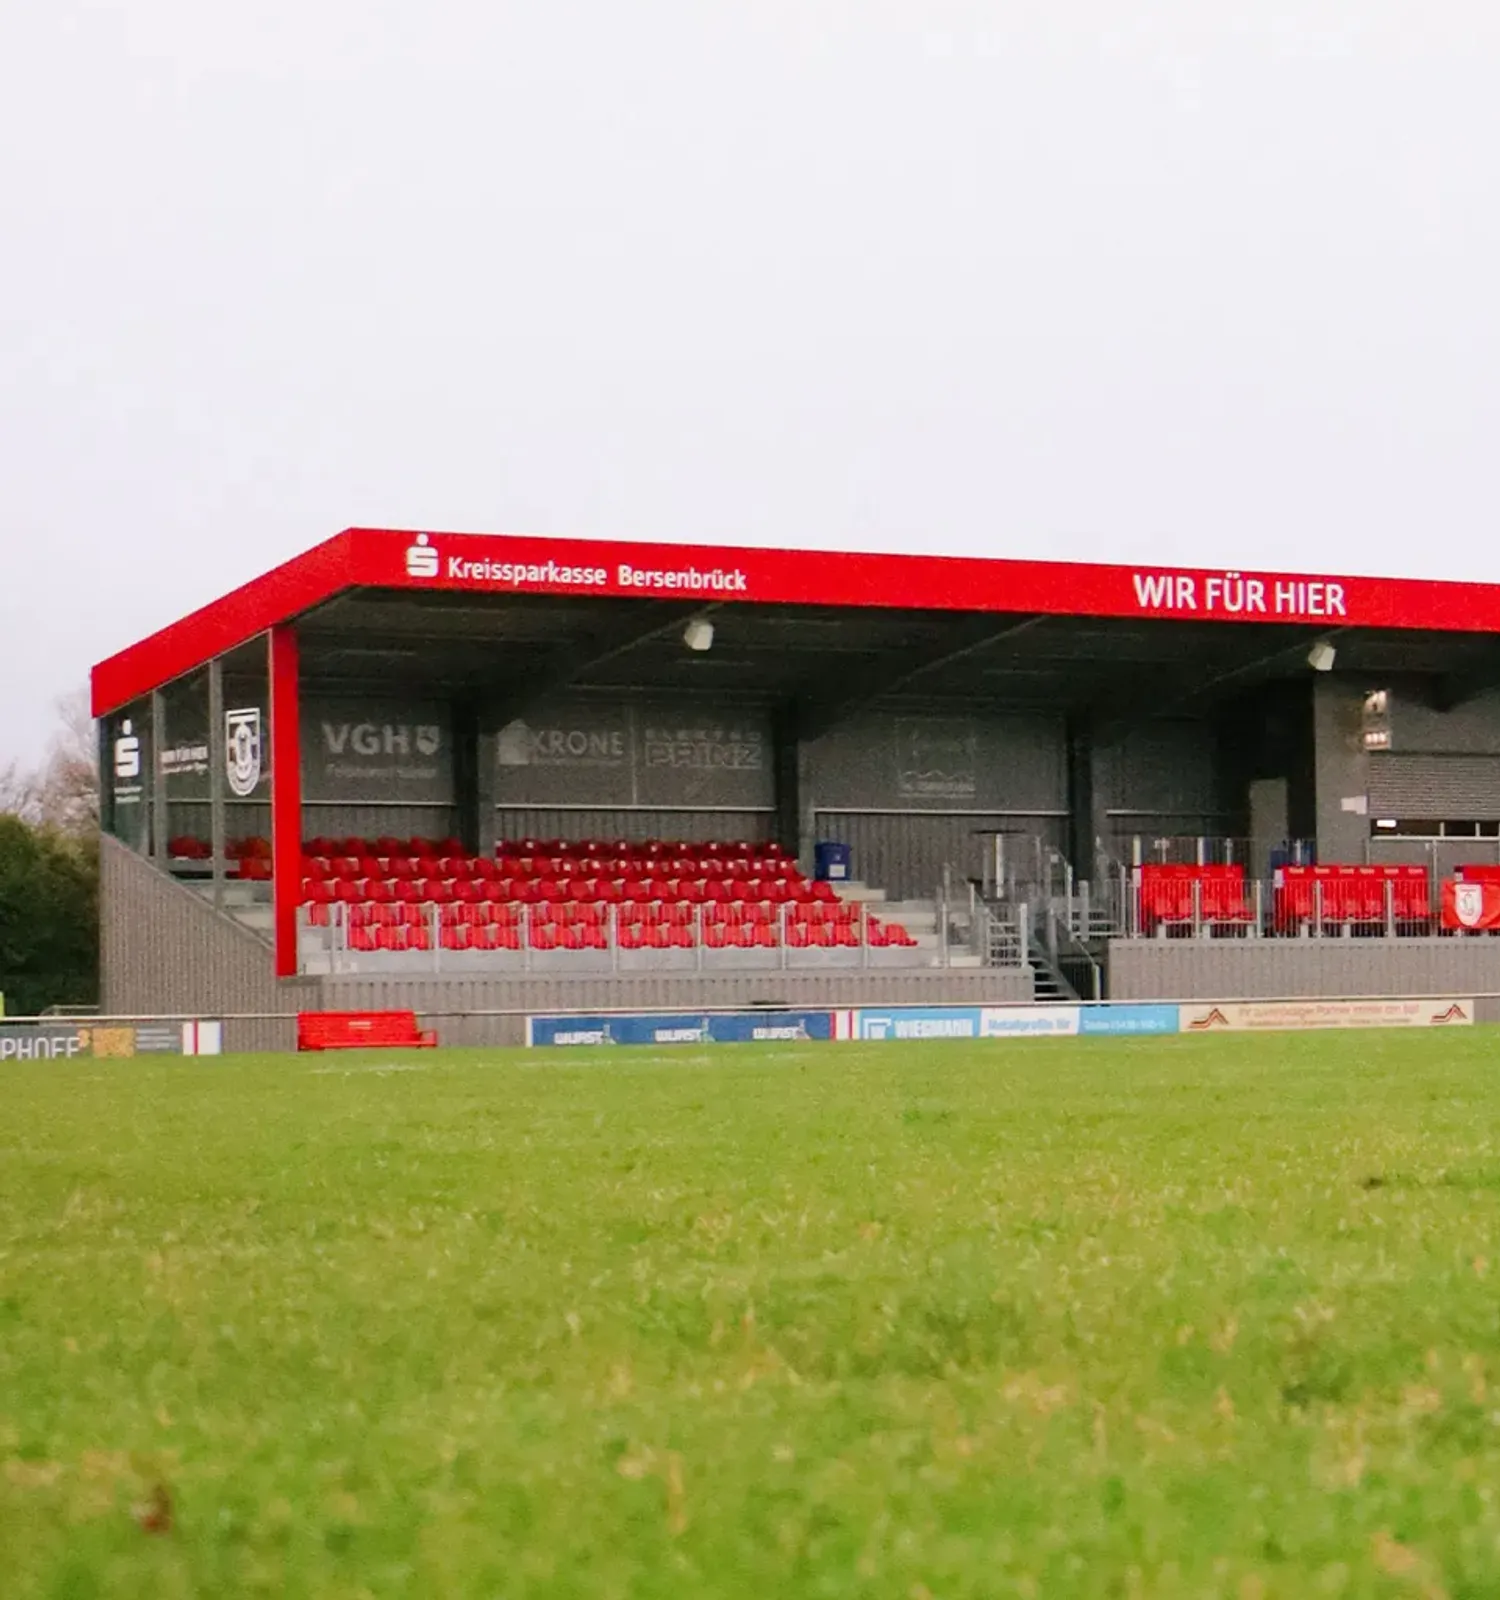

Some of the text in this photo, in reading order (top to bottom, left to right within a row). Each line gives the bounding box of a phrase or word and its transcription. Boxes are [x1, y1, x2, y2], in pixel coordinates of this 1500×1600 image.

[448, 556, 747, 591] Kreissparkasse Bersenbrück
[1133, 572, 1347, 616] WIR FÜR HIER
[322, 721, 410, 754] VGH
[531, 730, 624, 756] KRONE
